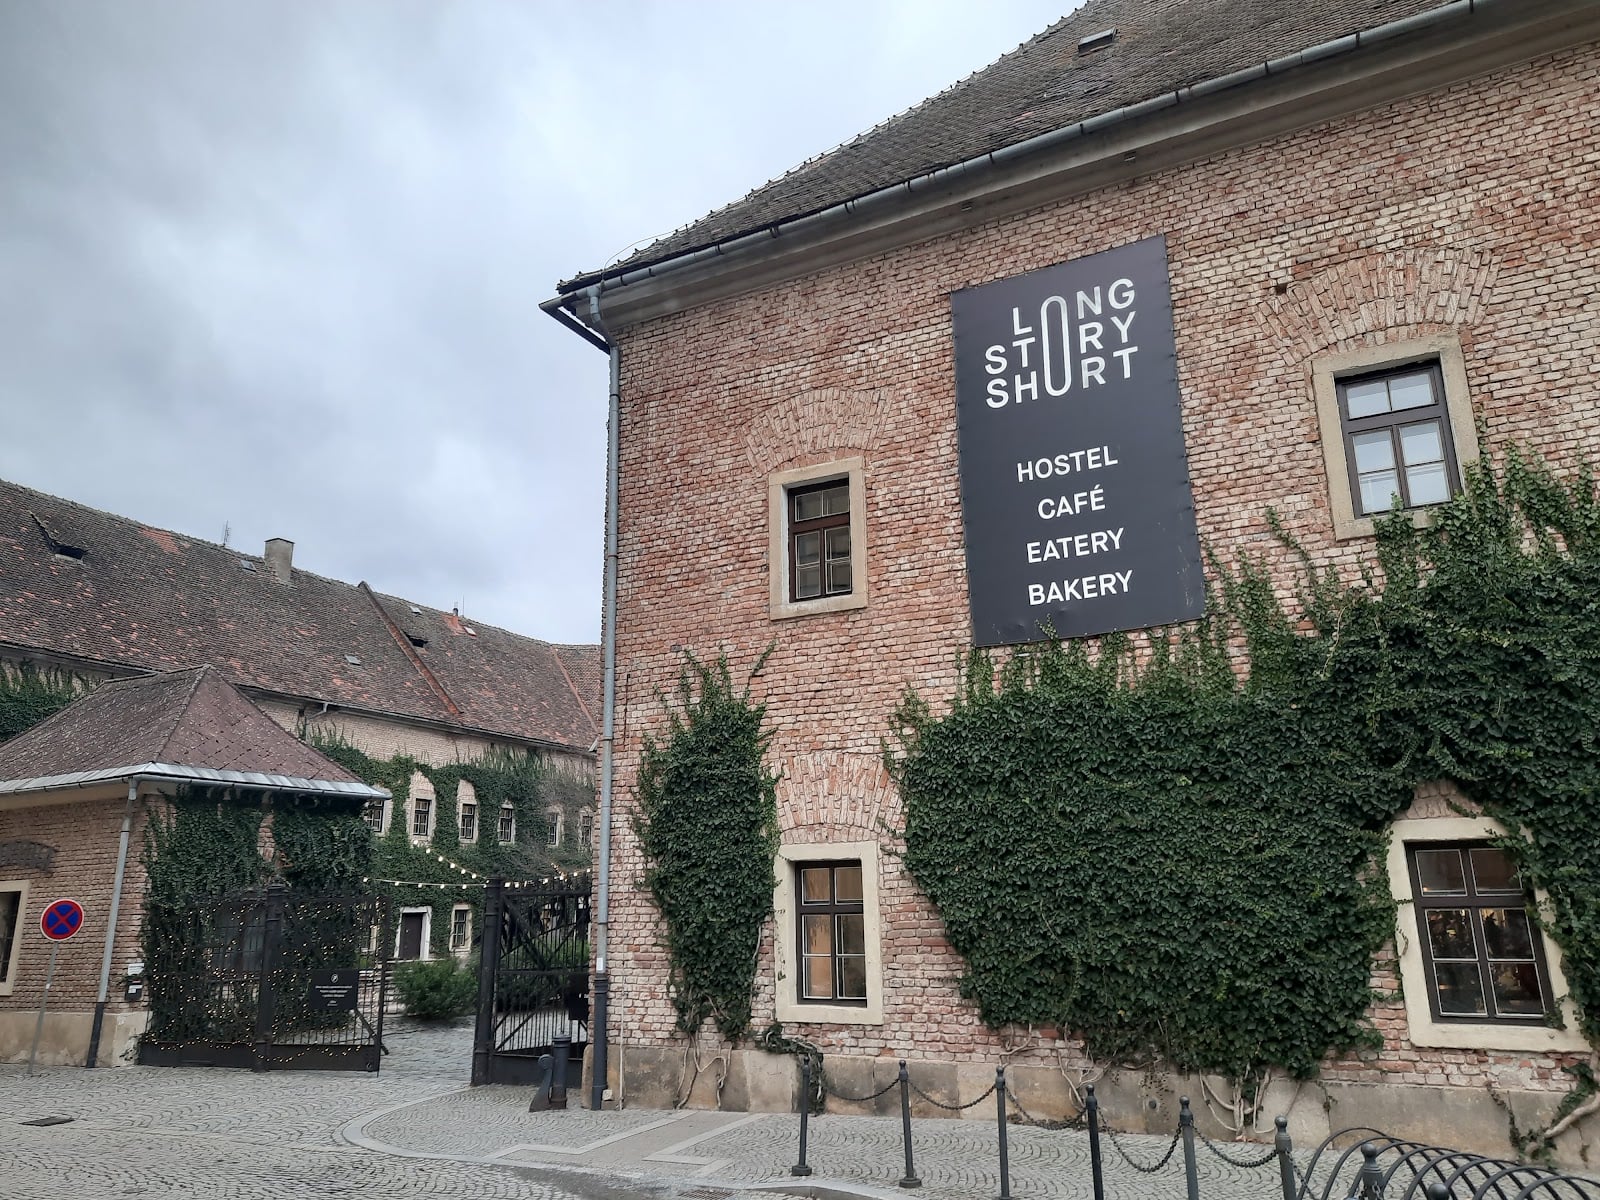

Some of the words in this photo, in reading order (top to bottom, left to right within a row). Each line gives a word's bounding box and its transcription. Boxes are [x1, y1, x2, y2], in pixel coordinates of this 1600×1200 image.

[1017, 445, 1118, 482] HOSTEL
[1038, 484, 1106, 519] CAFÉ
[1026, 527, 1125, 563] EATERY
[1028, 570, 1133, 605] BAKERY
